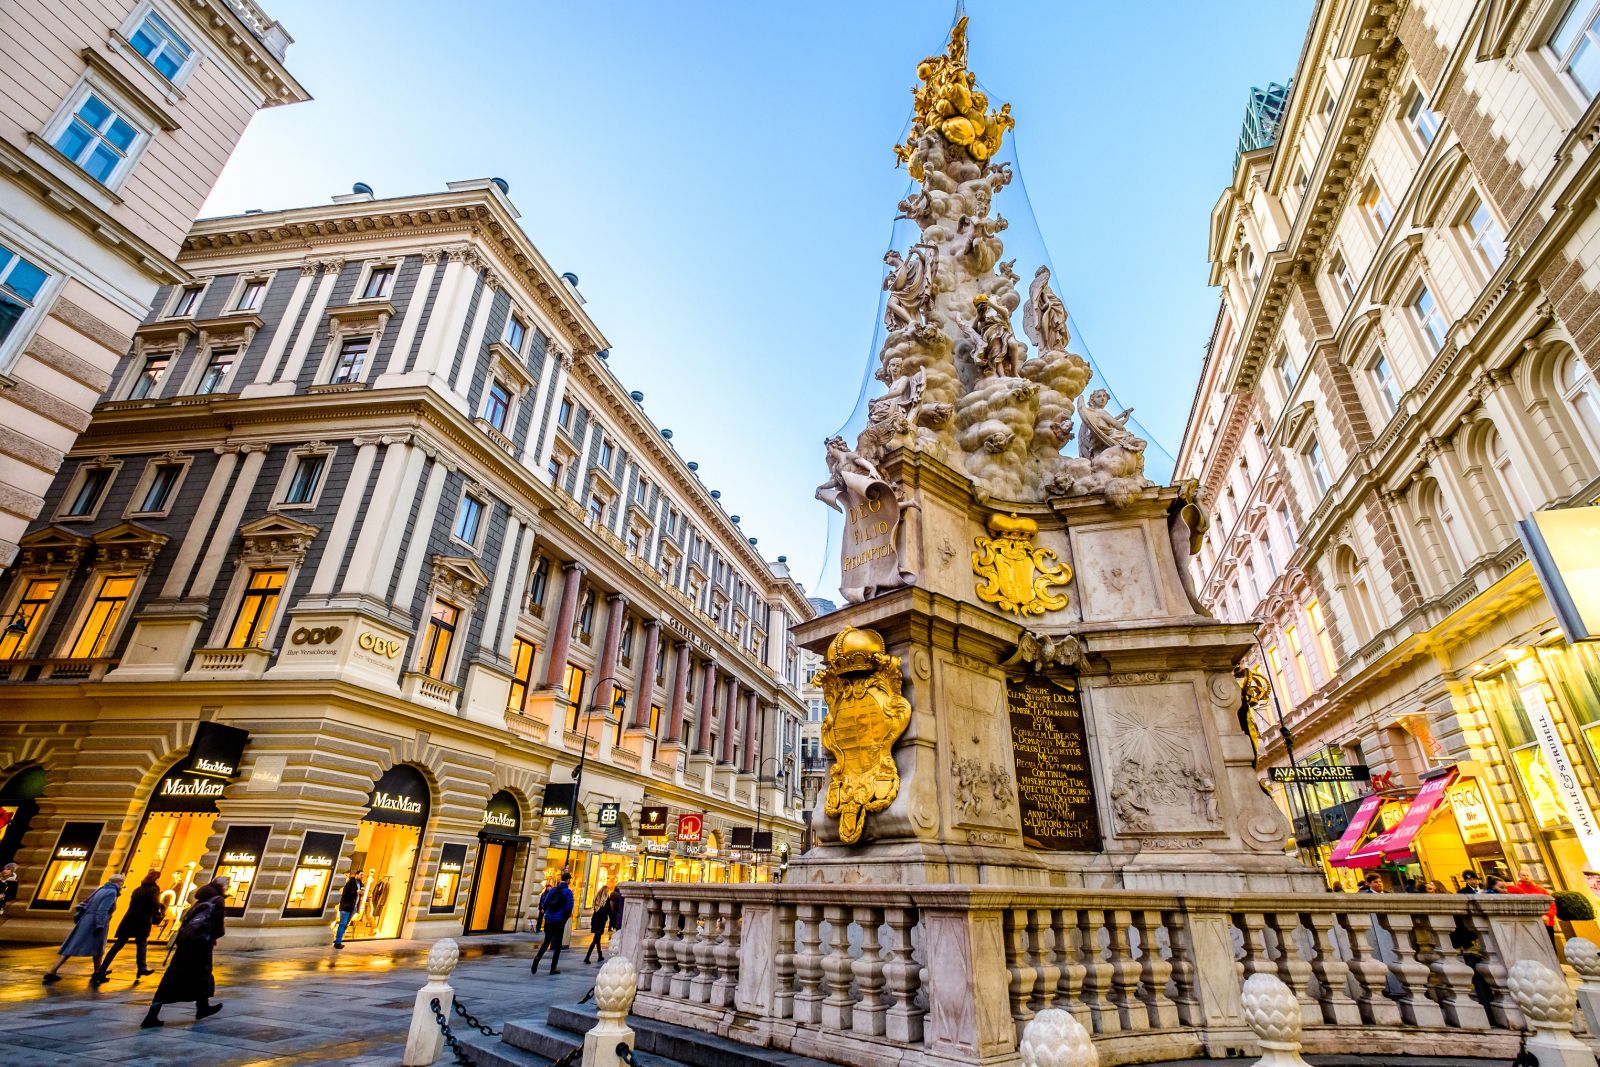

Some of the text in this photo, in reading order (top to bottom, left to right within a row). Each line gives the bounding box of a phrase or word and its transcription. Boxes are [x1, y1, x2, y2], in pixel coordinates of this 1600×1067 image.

[849, 499, 881, 525] DEO
[854, 520, 889, 546] FILIO
[669, 617, 696, 642] GRABEN
[700, 639, 712, 654] HOF
[300, 648, 338, 656] Versicherung
[195, 758, 233, 775] MaxMara
[1031, 767, 1068, 779] CONTINUA
[1274, 766, 1354, 778] AVANTGARDE
[160, 778, 225, 796] MaxMara
[1559, 772, 1574, 790] &
[372, 791, 422, 814] MaxMara
[1451, 785, 1482, 809] FRICK
[482, 810, 516, 828] MaxMara
[543, 807, 569, 816] MaxMara
[1027, 809, 1046, 819] ANNO
[57, 847, 89, 858] MaxMara
[223, 852, 256, 862] MaxMara
[303, 855, 332, 866] MaxMara
